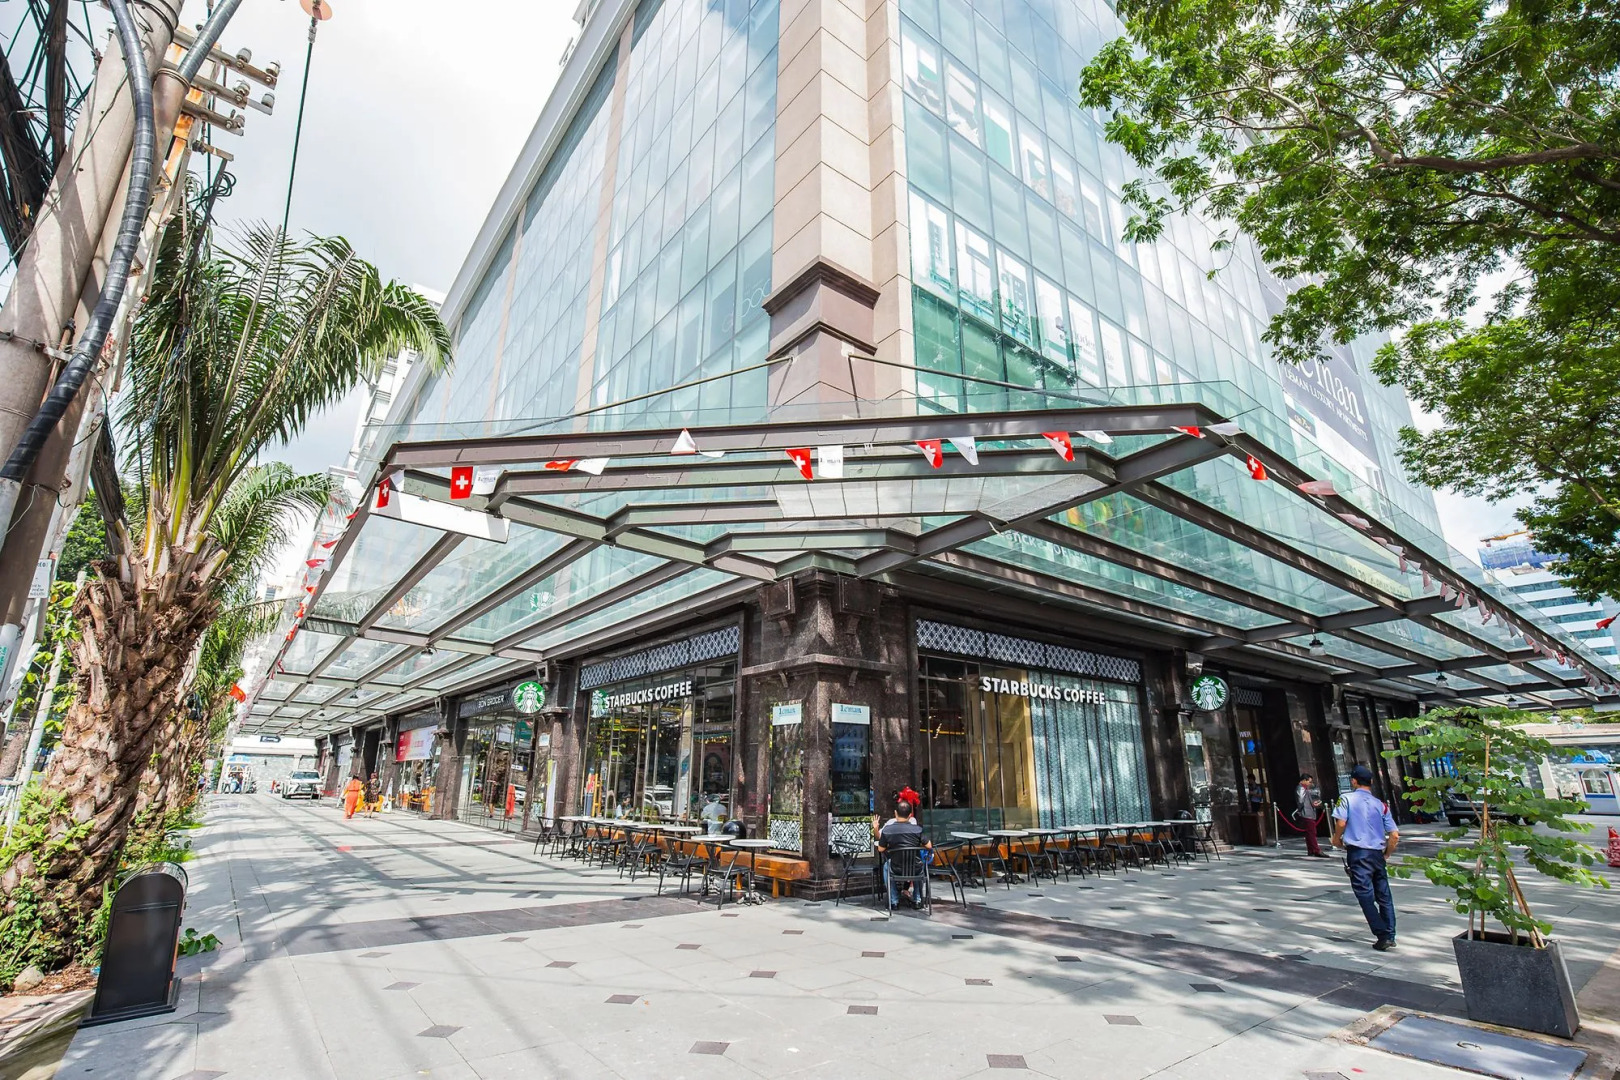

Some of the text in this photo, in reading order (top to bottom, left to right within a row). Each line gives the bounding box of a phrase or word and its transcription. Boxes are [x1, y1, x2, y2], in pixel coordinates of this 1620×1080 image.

[605, 681, 692, 708] STARBUCKS COFFEE
[982, 676, 1106, 705] STARBUCKS COFFEE
